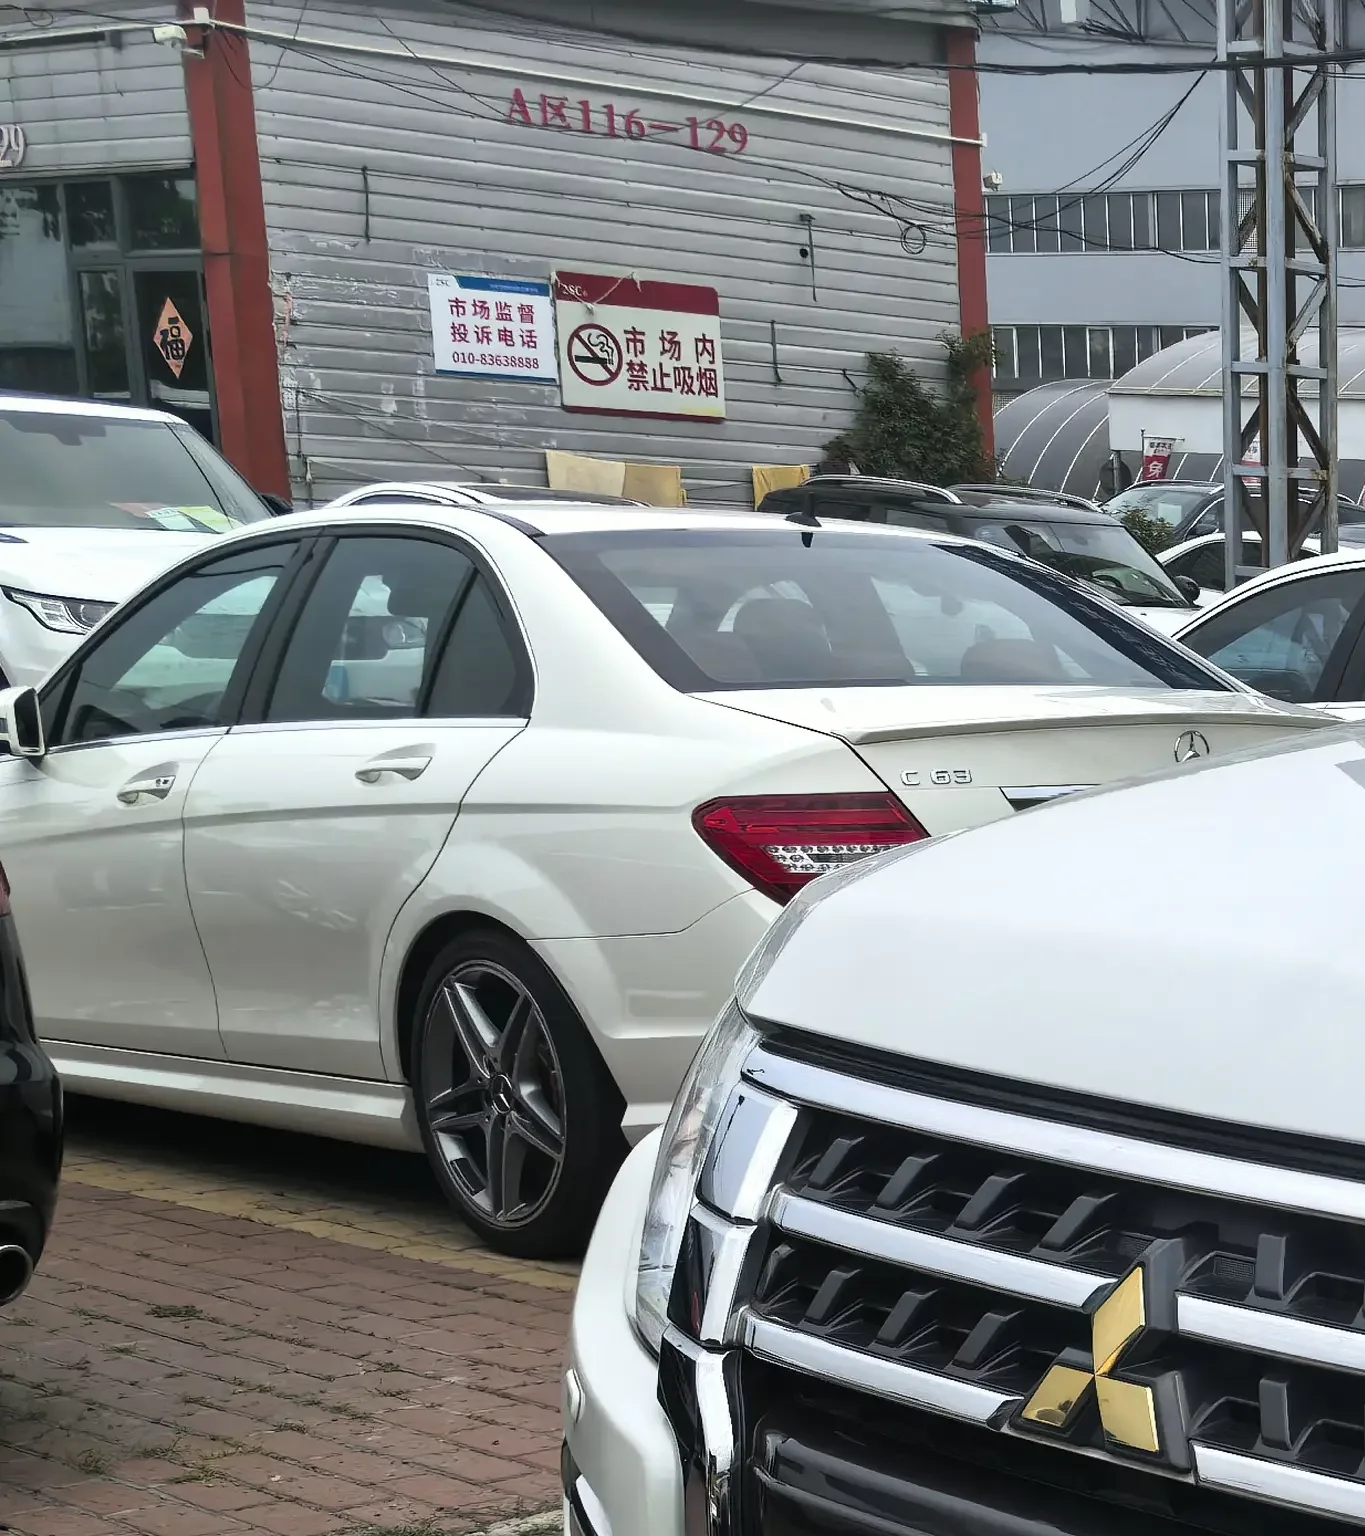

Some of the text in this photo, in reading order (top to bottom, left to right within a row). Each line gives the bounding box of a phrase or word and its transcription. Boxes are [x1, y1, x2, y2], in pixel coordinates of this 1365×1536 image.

[448, 297, 535, 324] 市场监督
[159, 316, 187, 361] 福
[450, 321, 539, 349] 投诉电话
[623, 326, 715, 364] 市场内
[452, 351, 540, 369] 010-83638888
[626, 359, 719, 398] 禁止吸烟
[900, 767, 973, 787] C 63
